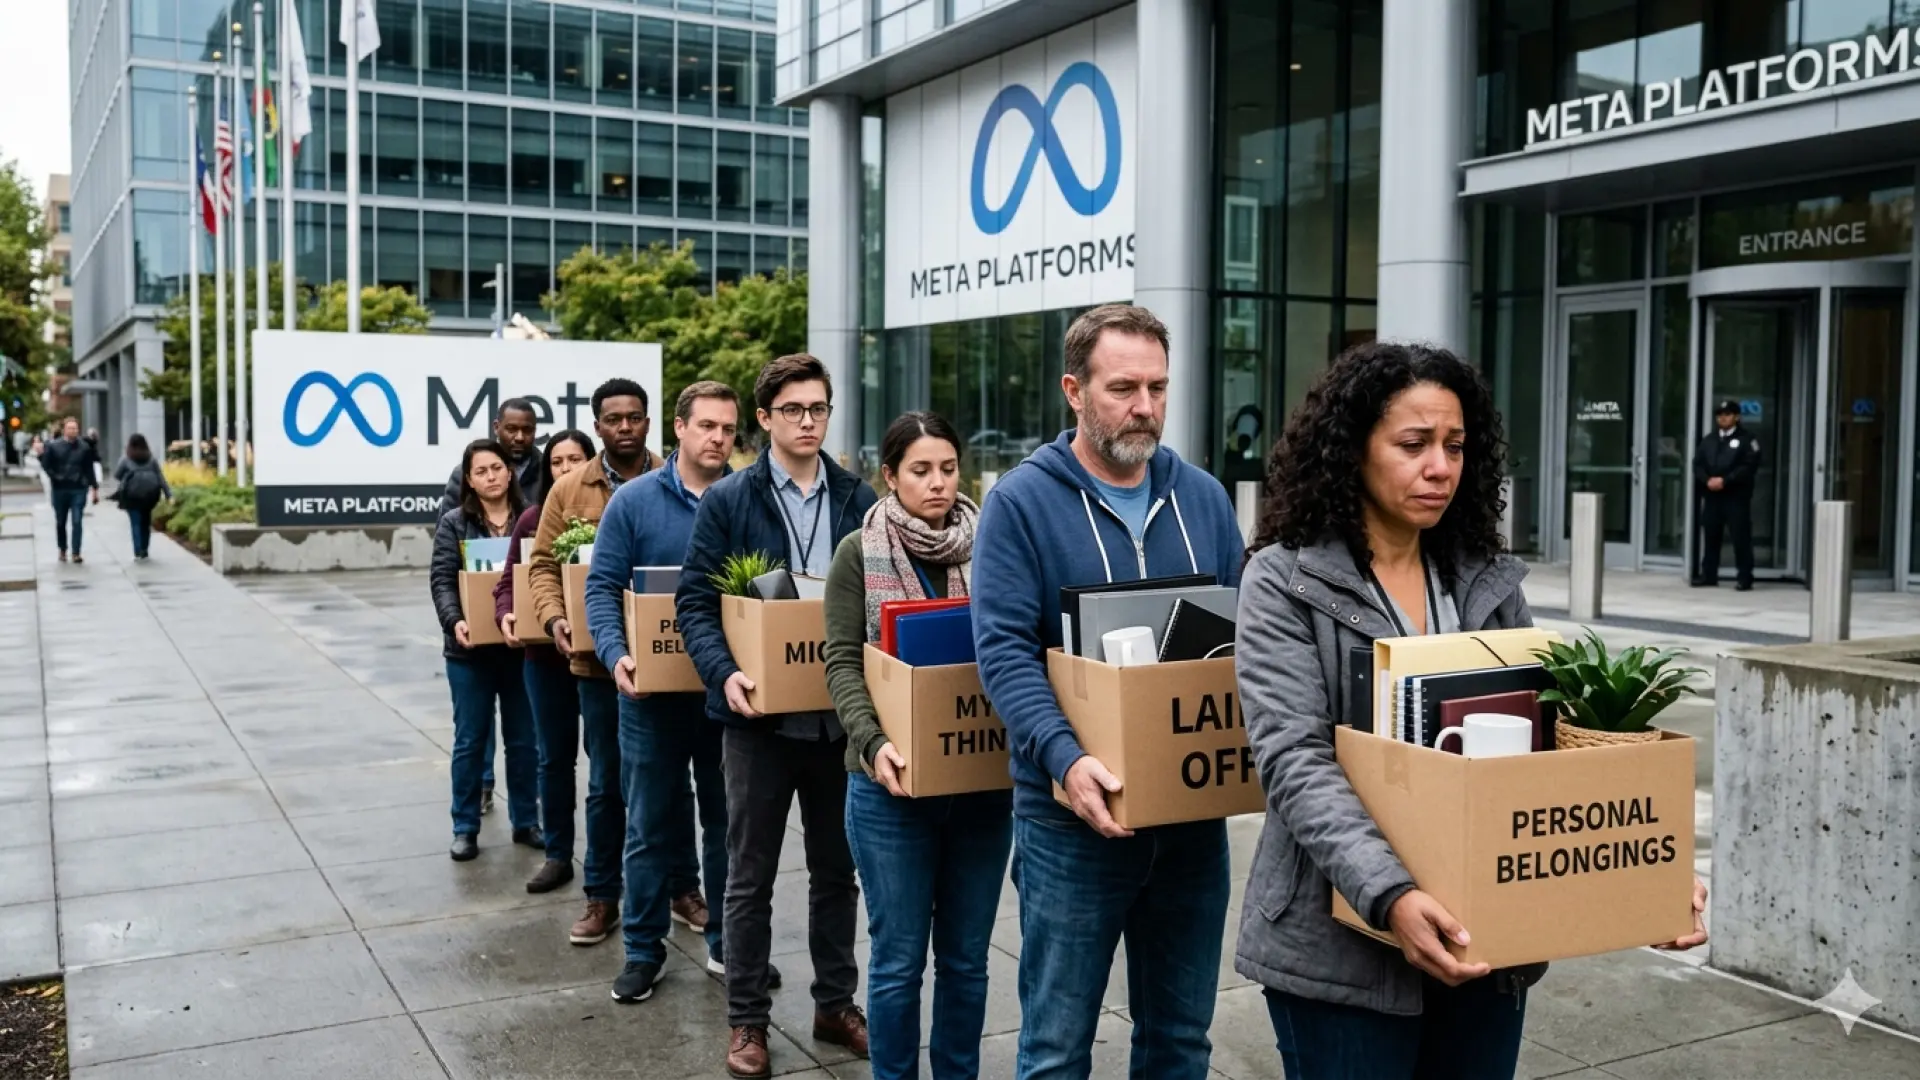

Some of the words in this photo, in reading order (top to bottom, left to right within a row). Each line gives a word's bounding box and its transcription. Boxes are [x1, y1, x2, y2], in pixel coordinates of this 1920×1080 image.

[1526, 90, 1633, 144] META
[1643, 27, 1920, 121] PLATFORM
[1739, 221, 1866, 255] ENTRANCE
[911, 263, 970, 298] META
[427, 376, 590, 446] Met
[284, 498, 338, 514] META
[342, 496, 443, 513] PLATFORM
[660, 619, 681, 633] PE
[652, 639, 685, 654] BEL
[956, 694, 992, 719] MY
[938, 728, 1006, 756] THIN
[1181, 746, 1255, 790] OFF
[1512, 796, 1659, 839] PERSONAL
[1497, 835, 1676, 884] BELONGINGS
